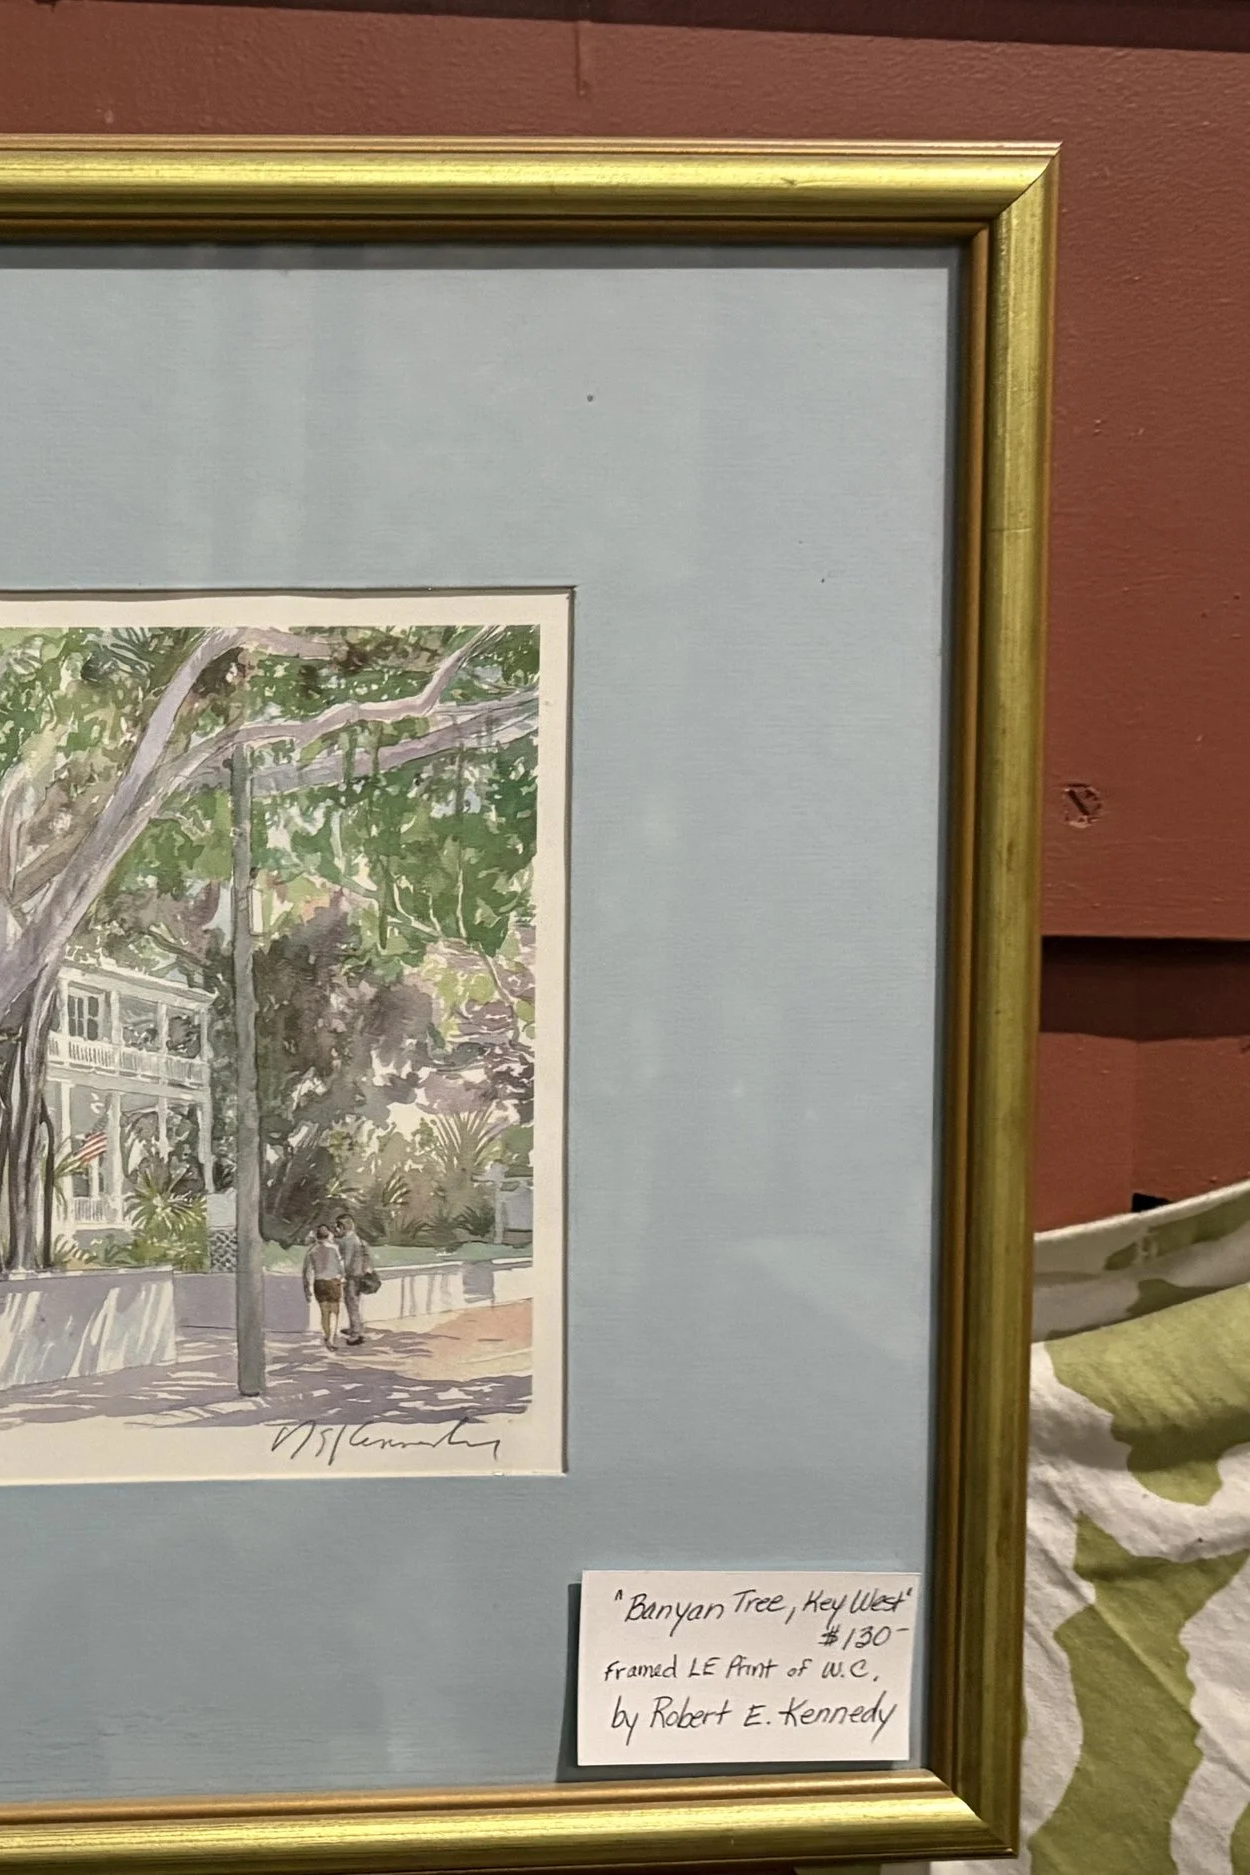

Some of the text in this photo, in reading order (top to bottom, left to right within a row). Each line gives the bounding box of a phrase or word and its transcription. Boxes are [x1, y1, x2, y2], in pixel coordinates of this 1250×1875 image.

[734, 1588, 797, 1625] Tree,
[802, 1589, 847, 1632] Key
[688, 1656, 720, 1678] LE
[725, 1654, 779, 1680] Print
[787, 1658, 813, 1678] of
[611, 1690, 898, 1746] by Robert E. Kennedy
